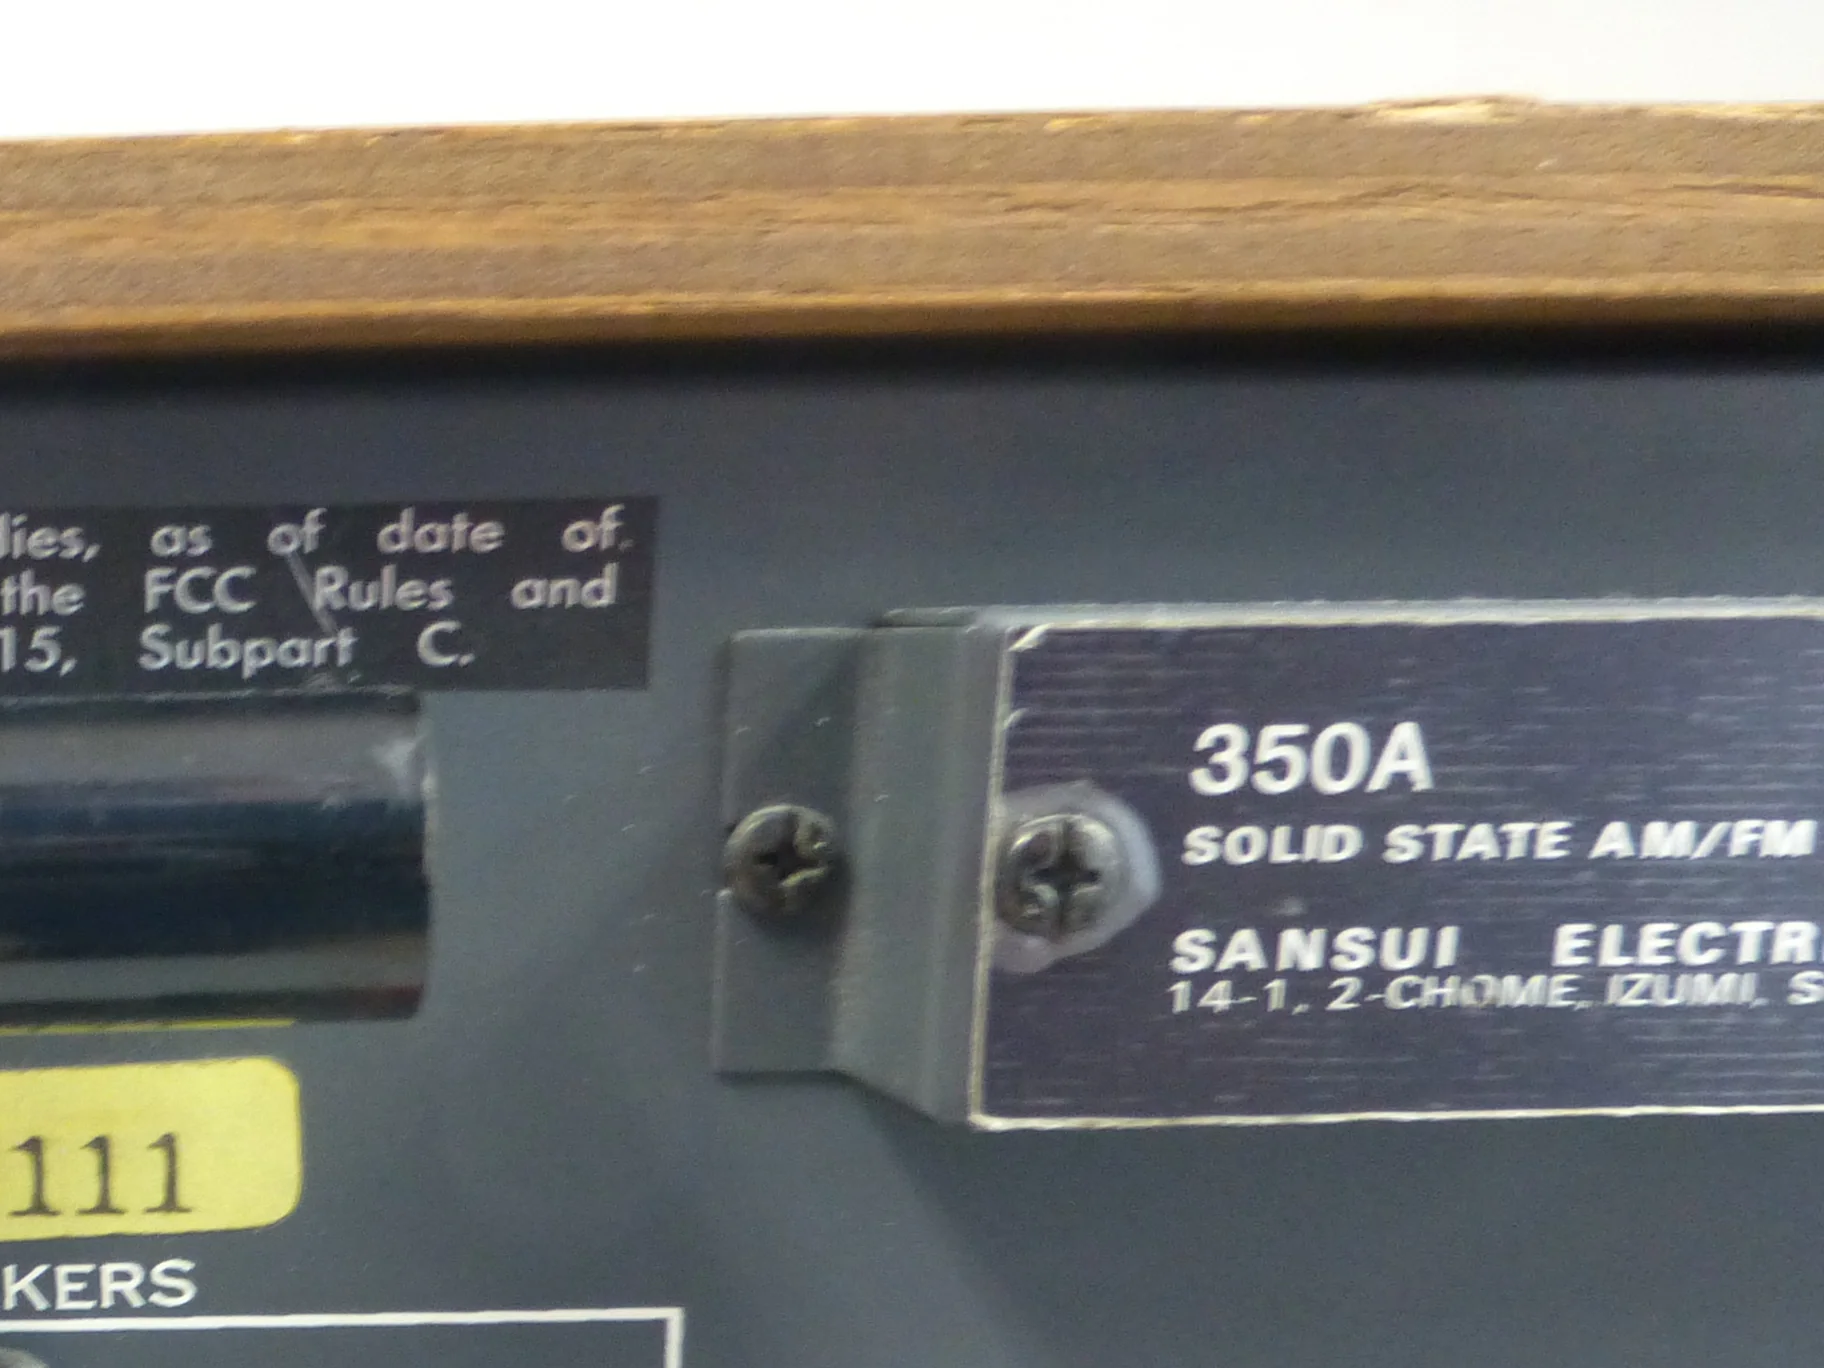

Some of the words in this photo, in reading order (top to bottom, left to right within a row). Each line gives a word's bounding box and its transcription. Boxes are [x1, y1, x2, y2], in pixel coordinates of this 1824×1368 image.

[150, 523, 213, 558] as
[267, 507, 328, 558] of
[377, 506, 505, 554] date
[0, 569, 86, 617] the
[143, 566, 257, 614] FCC
[313, 564, 455, 613] Rules
[511, 561, 620, 610] and
[139, 623, 360, 679] Subpart
[417, 620, 476, 668] C.
[1188, 721, 1434, 796] 350A
[1182, 824, 1366, 866] SOLID
[1382, 821, 1574, 864] STATE
[1589, 819, 1820, 861] AM/FM
[1169, 925, 1461, 972] SANSUI
[1551, 920, 1824, 967] ELECTR
[1786, 970, 1824, 1005] S
